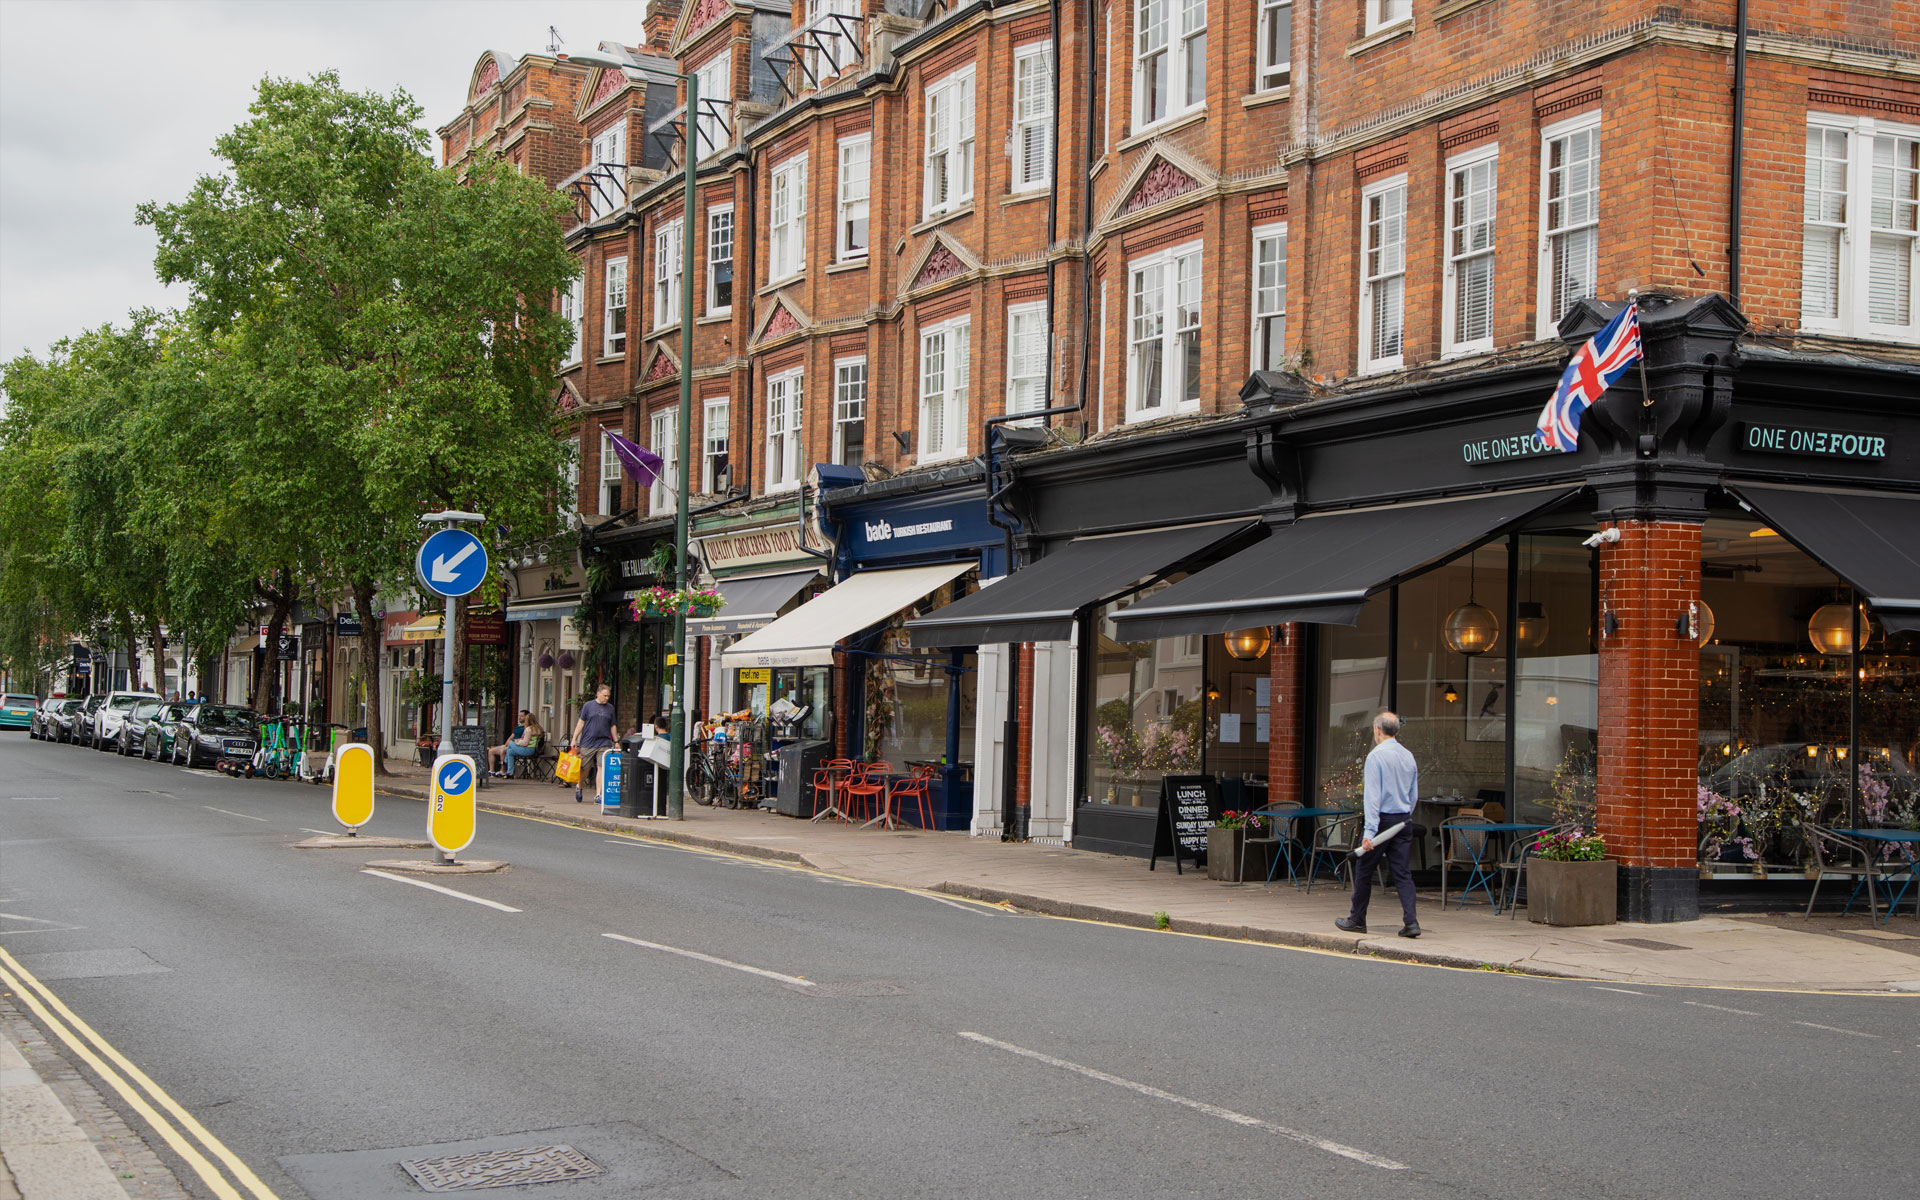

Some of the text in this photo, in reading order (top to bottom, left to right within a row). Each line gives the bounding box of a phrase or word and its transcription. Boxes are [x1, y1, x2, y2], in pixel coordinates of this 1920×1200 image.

[1749, 427, 1787, 449] ONE
[1463, 441, 1490, 463] ONE
[865, 519, 953, 542] bade TURKISH RESTAURANT
[707, 539, 735, 565] QUALITY
[770, 530, 792, 553] FOOD
[620, 560, 631, 578] THE
[1176, 790, 1206, 799] LUNCH
[1178, 805, 1209, 814] DINNER
[1175, 821, 1198, 830] SUNDAY
[1197, 820, 1216, 829] LUNCH
[1180, 836, 1200, 845] HAPPY
